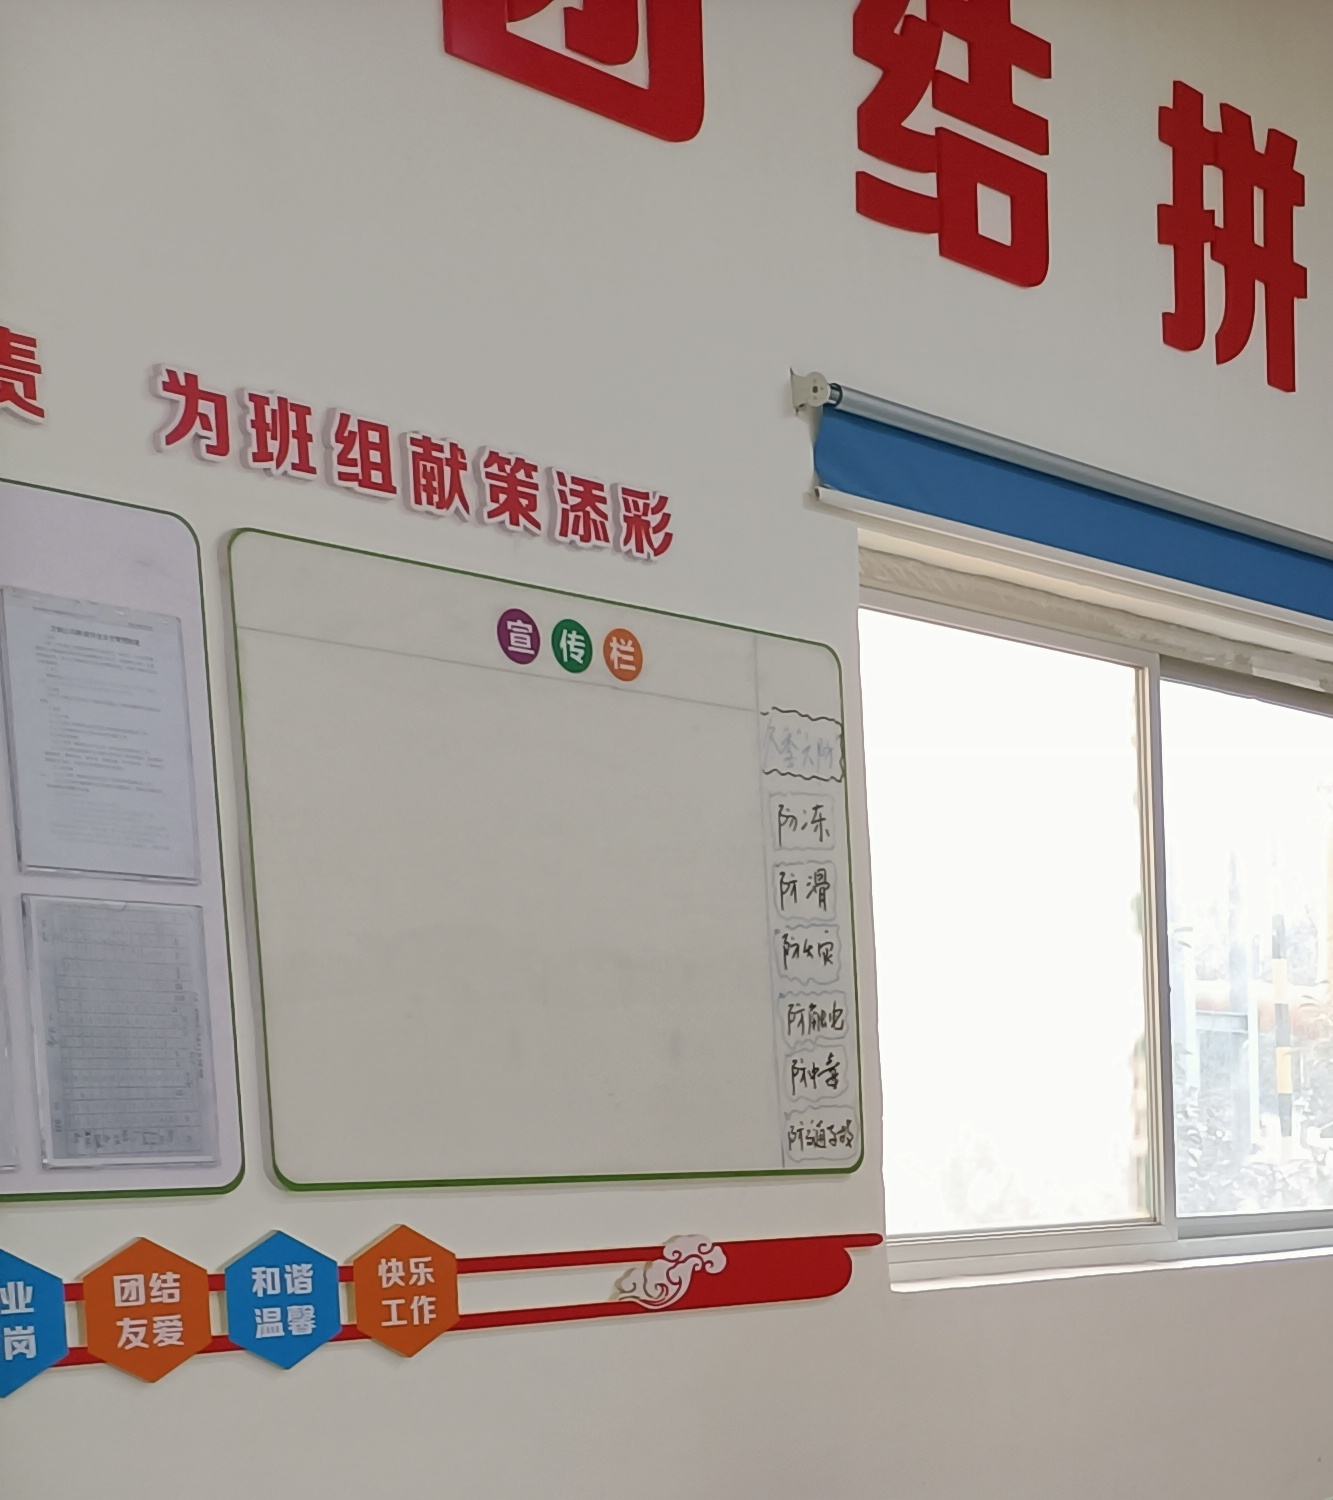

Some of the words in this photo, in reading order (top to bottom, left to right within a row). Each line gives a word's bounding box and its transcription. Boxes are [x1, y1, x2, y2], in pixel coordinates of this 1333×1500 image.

[160, 368, 675, 560] 为班组献策添彩
[502, 614, 640, 678] 宣传栏
[778, 804, 831, 848] 防冻
[779, 867, 831, 912] 防滑
[112, 1270, 182, 1308] 团结
[251, 1263, 313, 1298] 和谐
[377, 1255, 436, 1288] 快乐
[0, 1281, 35, 1315] 业
[379, 1295, 438, 1329] 工作
[116, 1315, 186, 1351] 友爱
[254, 1303, 317, 1338] 温馨
[3, 1325, 37, 1361] 岗
